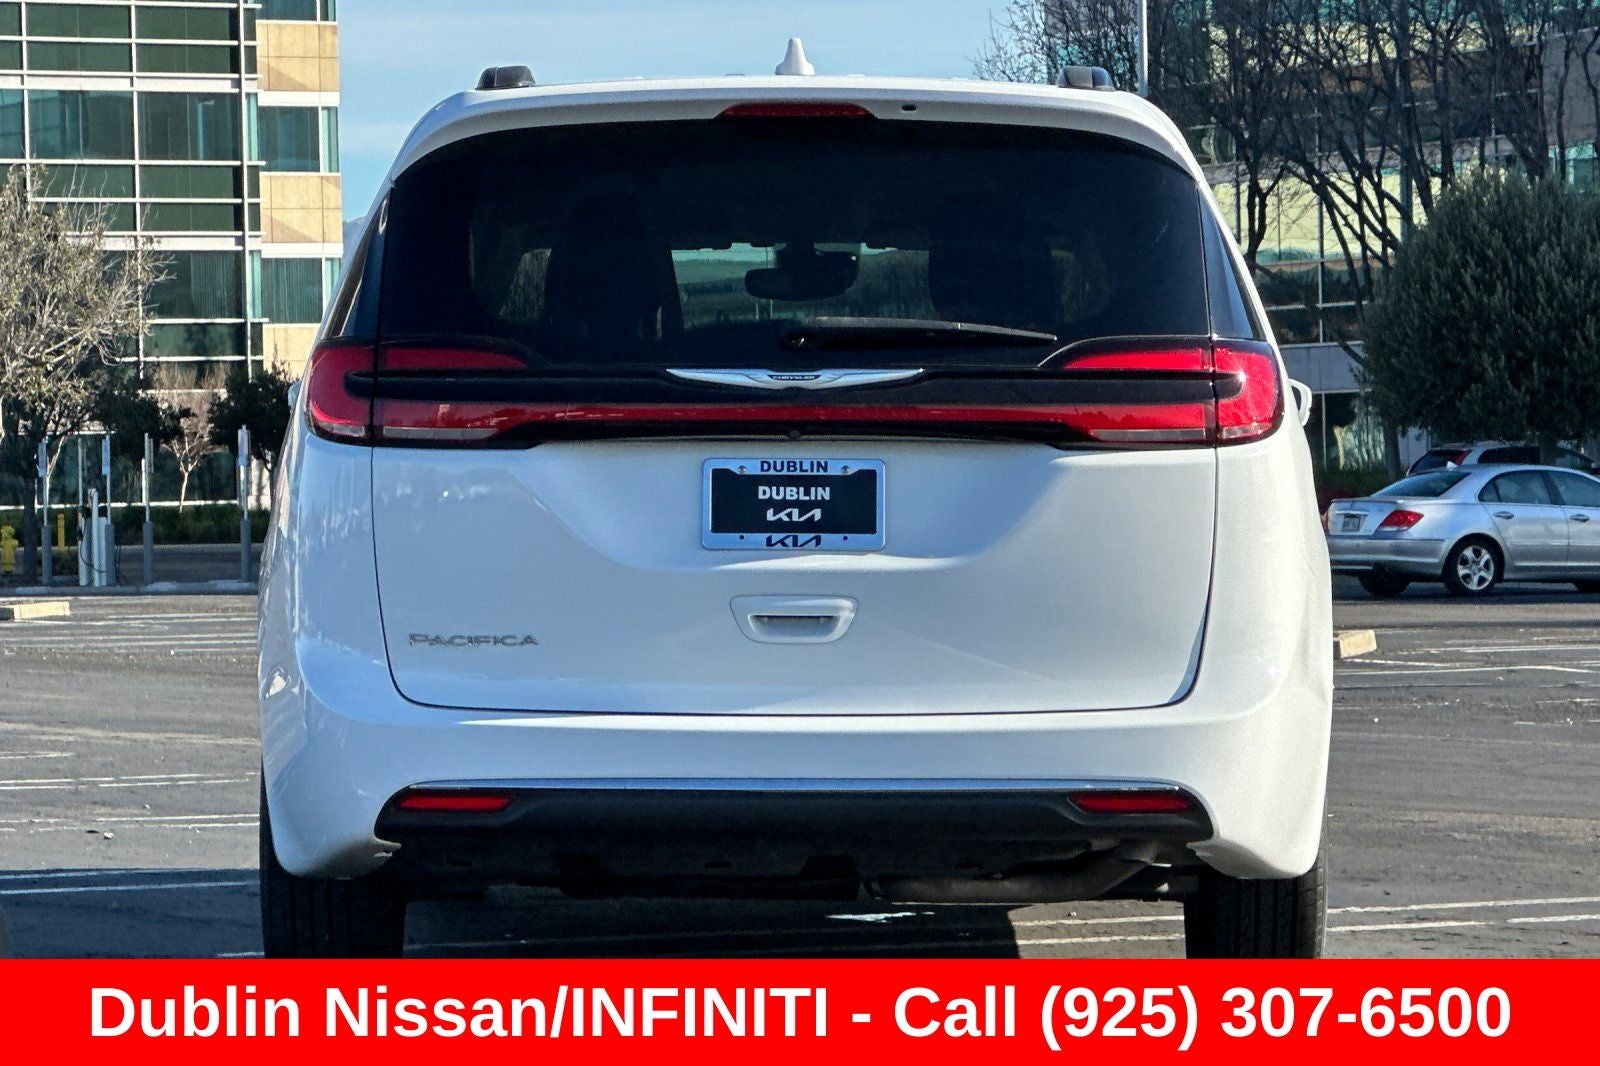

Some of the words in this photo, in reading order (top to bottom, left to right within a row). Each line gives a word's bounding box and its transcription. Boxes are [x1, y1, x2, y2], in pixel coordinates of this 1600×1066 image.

[760, 460, 828, 473] DUBLIN
[758, 486, 830, 501] DUBLIN
[766, 508, 822, 522] KIA
[765, 534, 822, 548] KIA
[408, 633, 539, 646] PACIFICA
